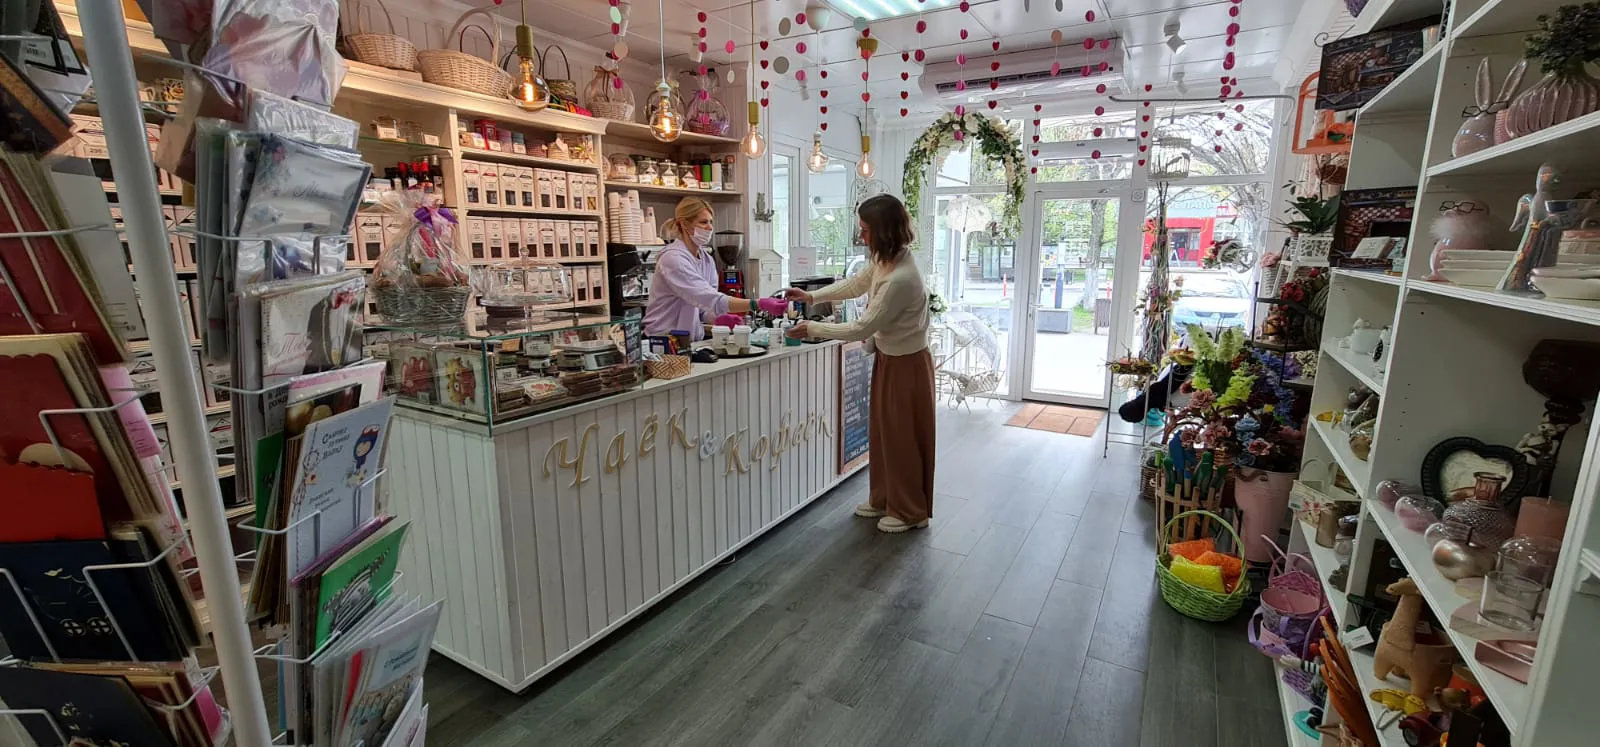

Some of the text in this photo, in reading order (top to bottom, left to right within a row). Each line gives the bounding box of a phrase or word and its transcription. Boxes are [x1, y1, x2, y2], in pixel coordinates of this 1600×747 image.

[543, 407, 698, 488] Чаёк
[700, 430, 717, 460] &
[721, 409, 833, 475] Кофеёк
